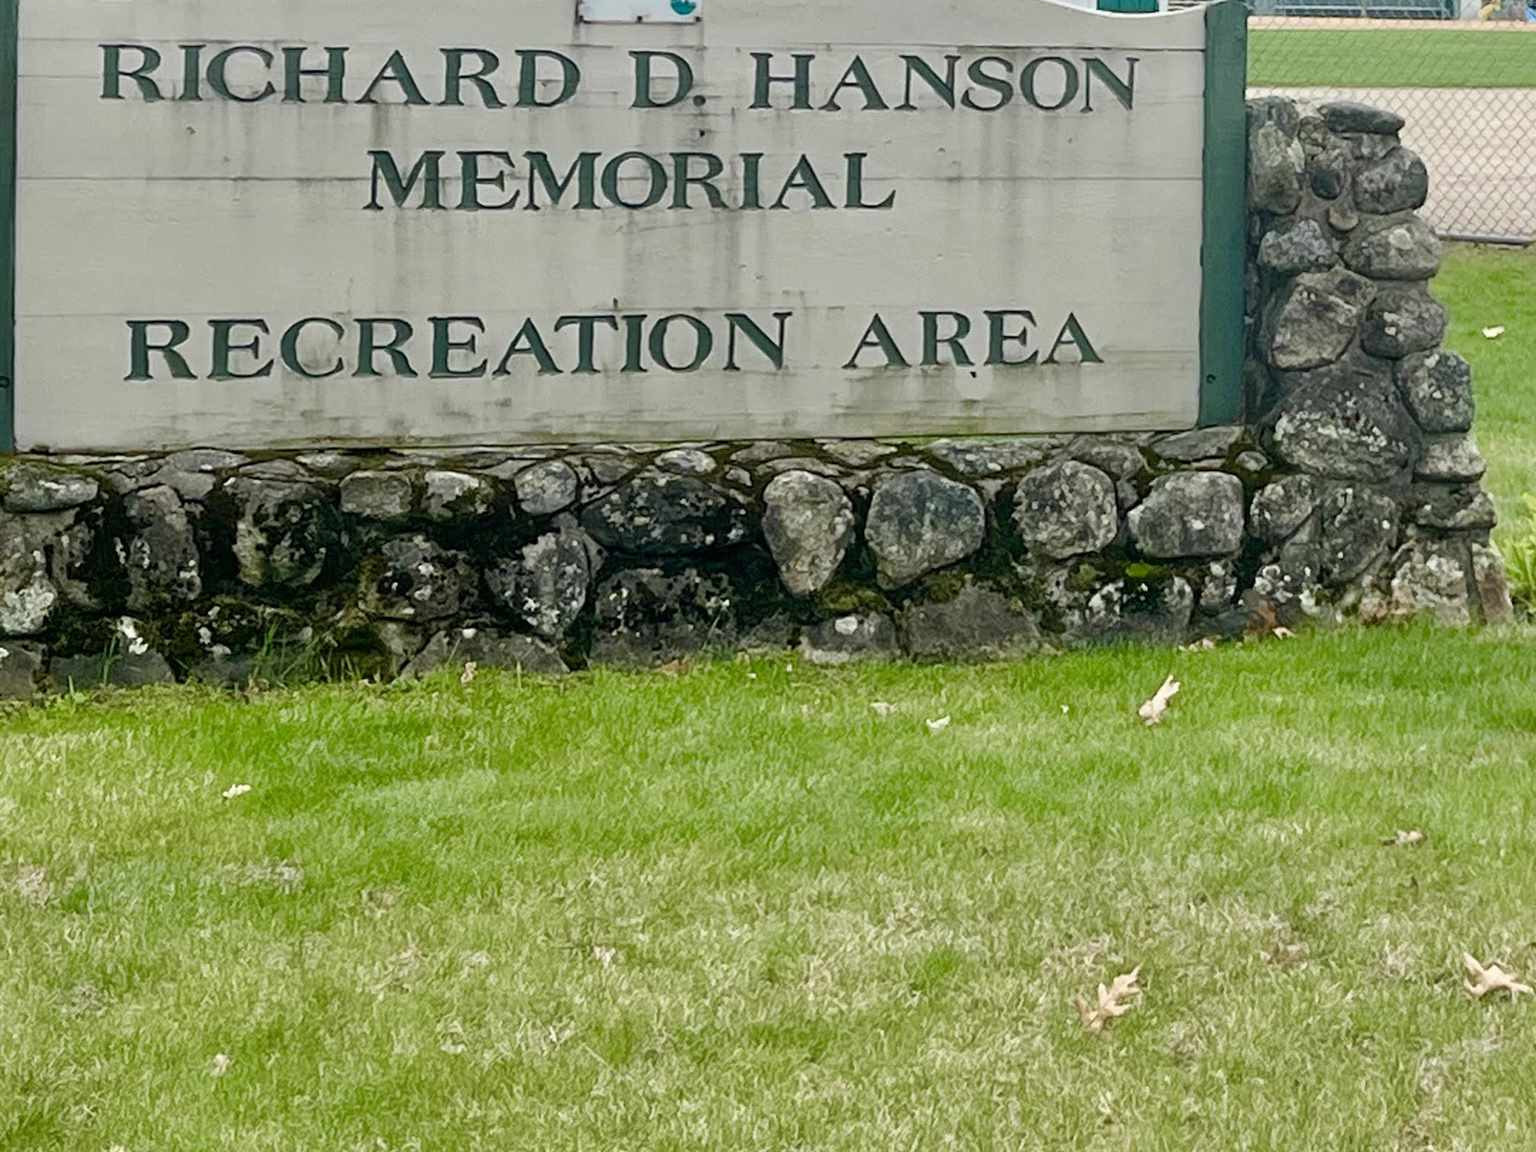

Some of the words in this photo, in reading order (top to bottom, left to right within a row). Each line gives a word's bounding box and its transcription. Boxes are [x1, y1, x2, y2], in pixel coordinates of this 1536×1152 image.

[98, 42, 581, 110] RICHARD
[628, 50, 707, 110] D.
[748, 51, 1140, 112] HANSON
[361, 150, 896, 211] MEMORIAL
[123, 310, 794, 381] RECREATION
[841, 309, 1104, 369] AREA
